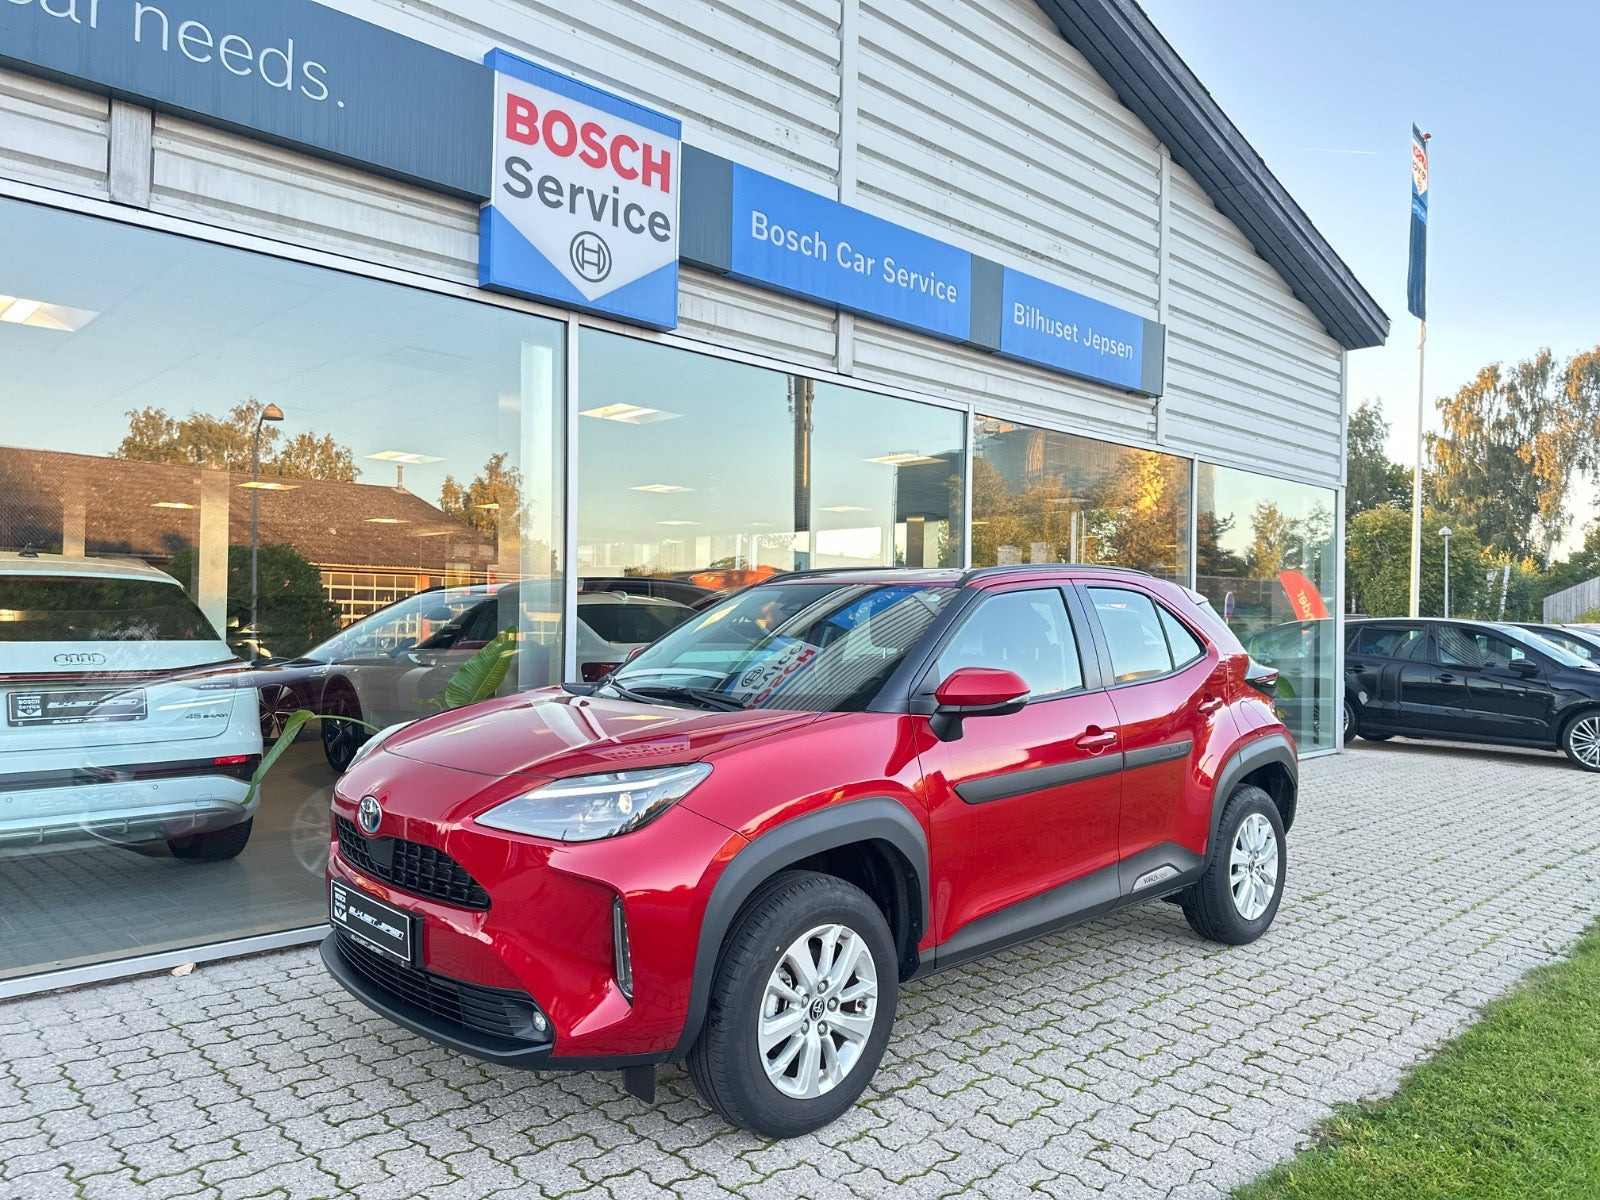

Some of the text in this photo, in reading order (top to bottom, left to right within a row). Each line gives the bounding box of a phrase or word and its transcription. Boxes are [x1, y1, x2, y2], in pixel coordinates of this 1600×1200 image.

[4, 0, 345, 108] ar needs.
[506, 92, 671, 194] BOSCH
[502, 156, 671, 242] Service
[752, 210, 957, 303] Bosch Car Service
[1014, 302, 1133, 360] Bilhuset Jepsen
